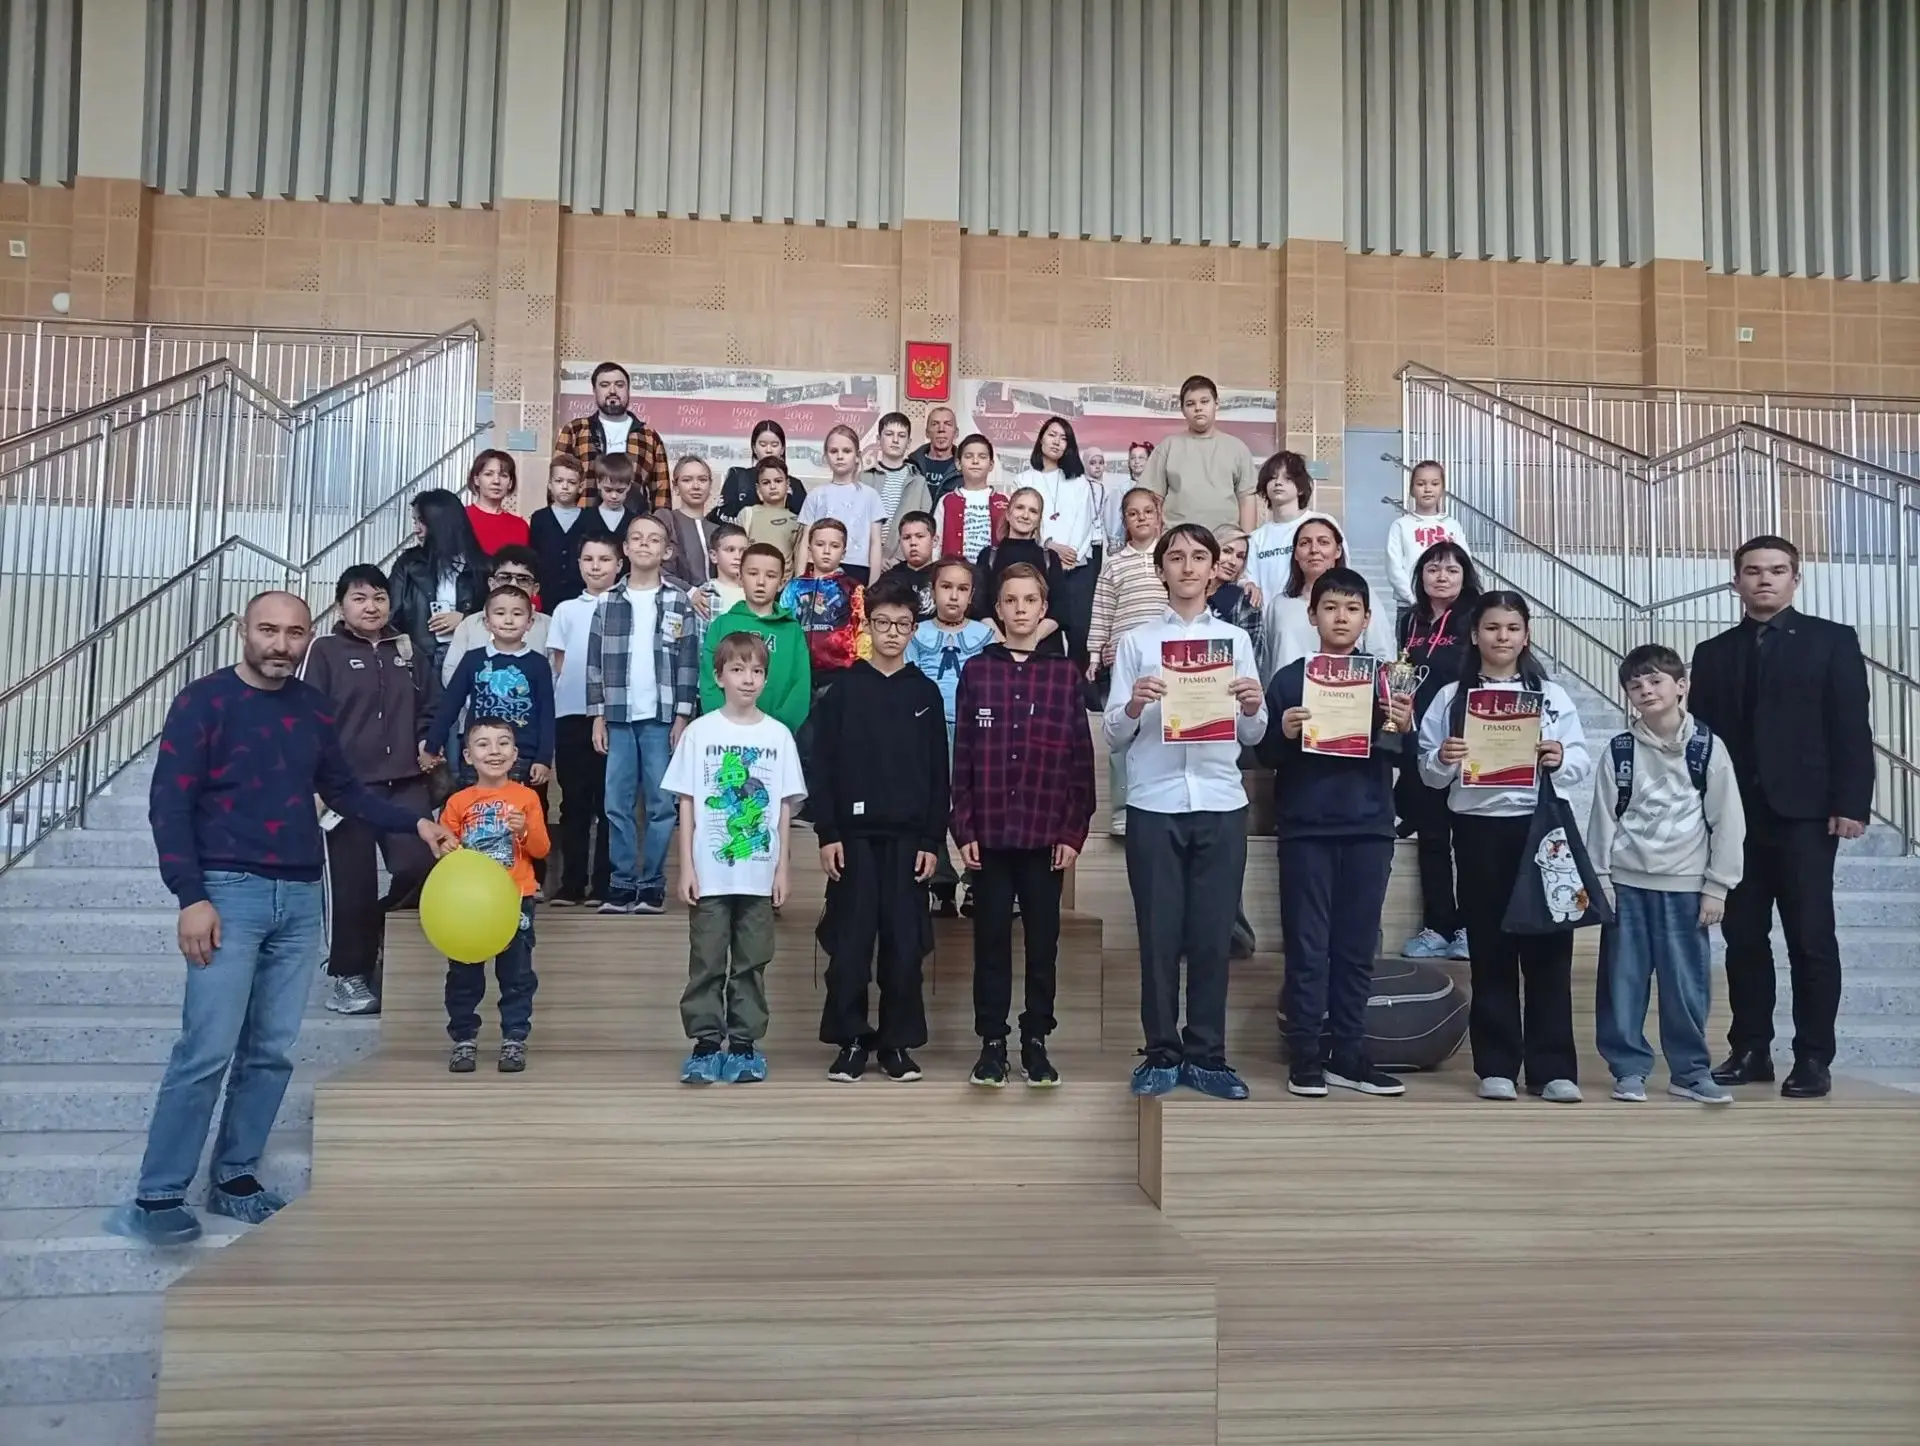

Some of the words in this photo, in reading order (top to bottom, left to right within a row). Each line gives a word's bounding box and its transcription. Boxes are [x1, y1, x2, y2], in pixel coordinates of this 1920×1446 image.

[677, 404, 704, 416] 1980
[731, 407, 757, 418] 1990
[784, 409, 814, 421] 2000
[680, 416, 707, 428] 1990
[834, 412, 861, 424] 2010
[788, 421, 814, 433] 2010
[988, 420, 1016, 430] 2020
[1178, 676, 1217, 684] ГРАМОТА
[1319, 689, 1355, 699] ГРАМОТА
[1482, 724, 1522, 732] ГРАМОТА
